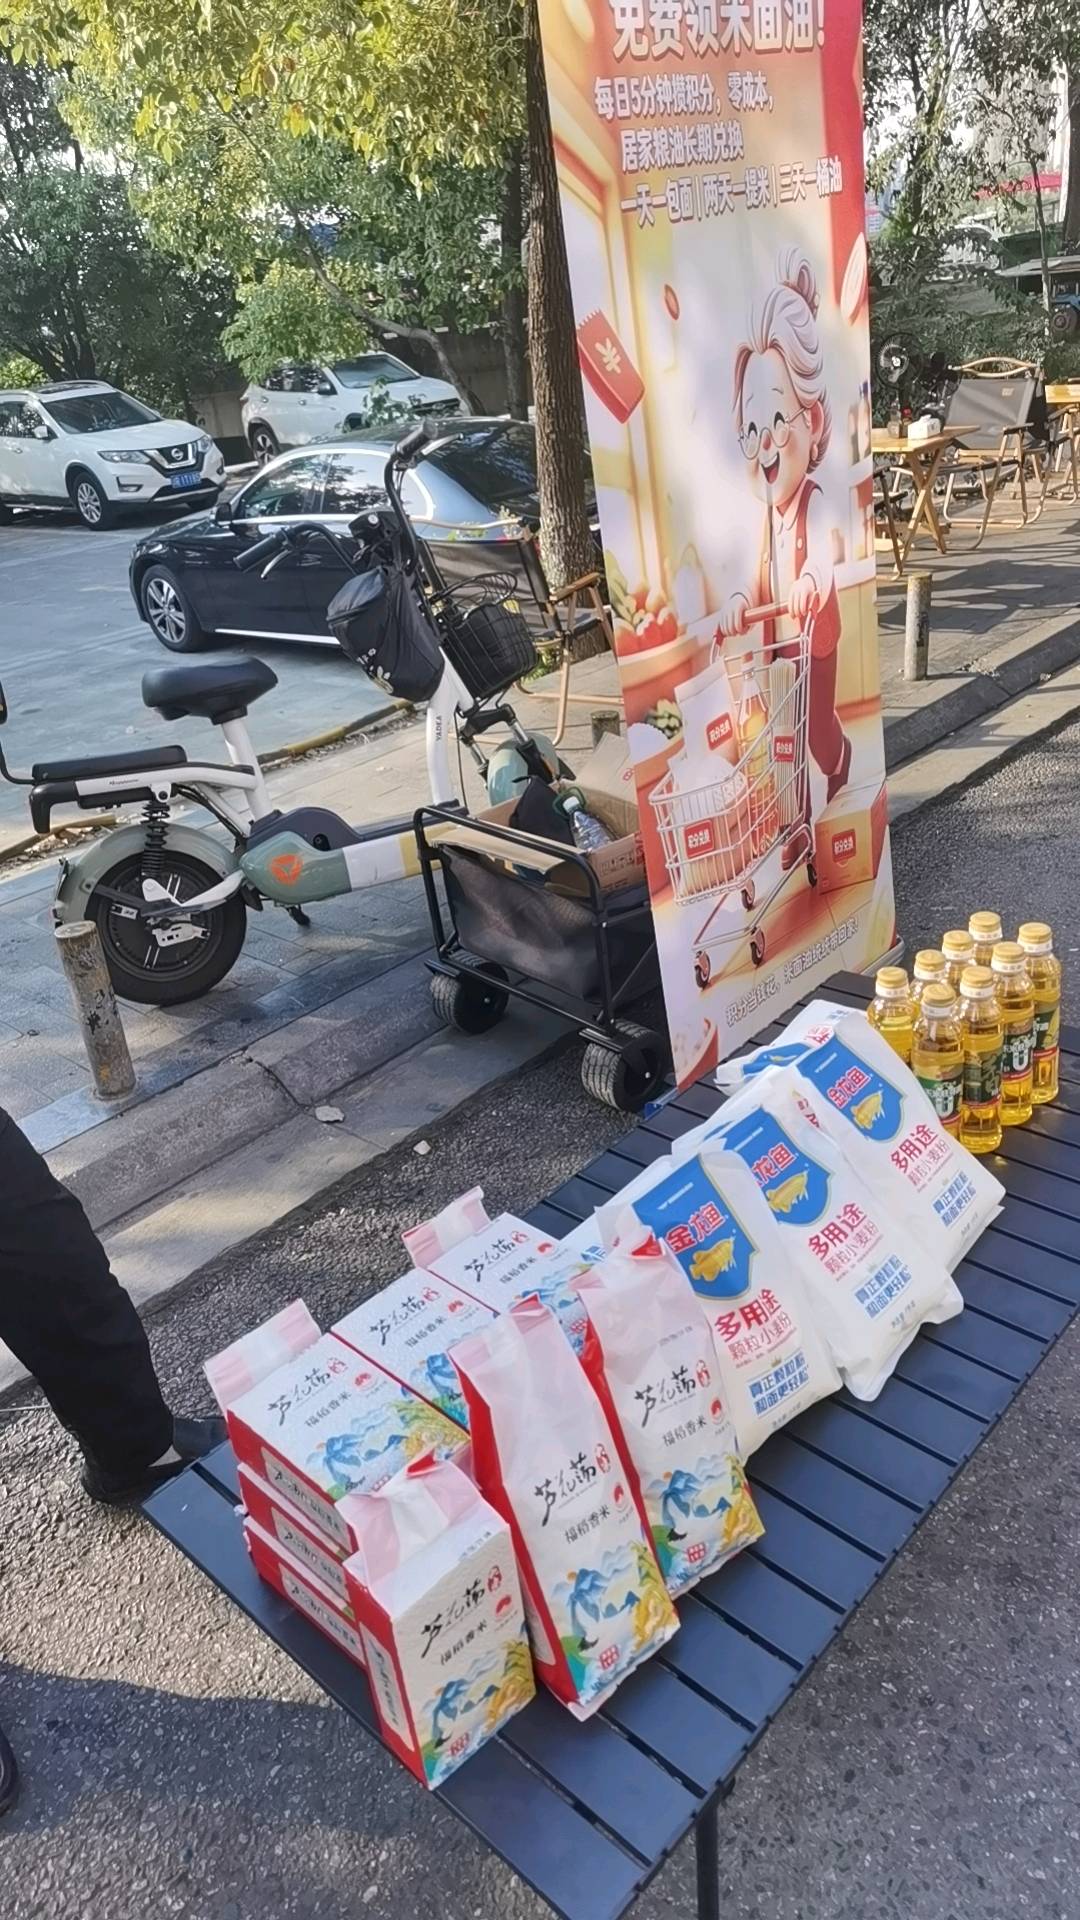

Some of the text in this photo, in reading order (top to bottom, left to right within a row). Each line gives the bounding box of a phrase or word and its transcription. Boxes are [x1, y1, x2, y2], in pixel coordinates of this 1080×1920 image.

[621, 119, 744, 172] 居家粮油长期兑换
[752, 1142, 797, 1187] 龙鱼
[891, 1124, 938, 1173] 多用途
[664, 1201, 726, 1254] 金龙鱼
[808, 1202, 867, 1261] 多用途
[824, 1222, 880, 1275] 颗粒小麦粉
[714, 1288, 783, 1342] 多用途
[727, 1313, 793, 1360] 颗粒小麦粉
